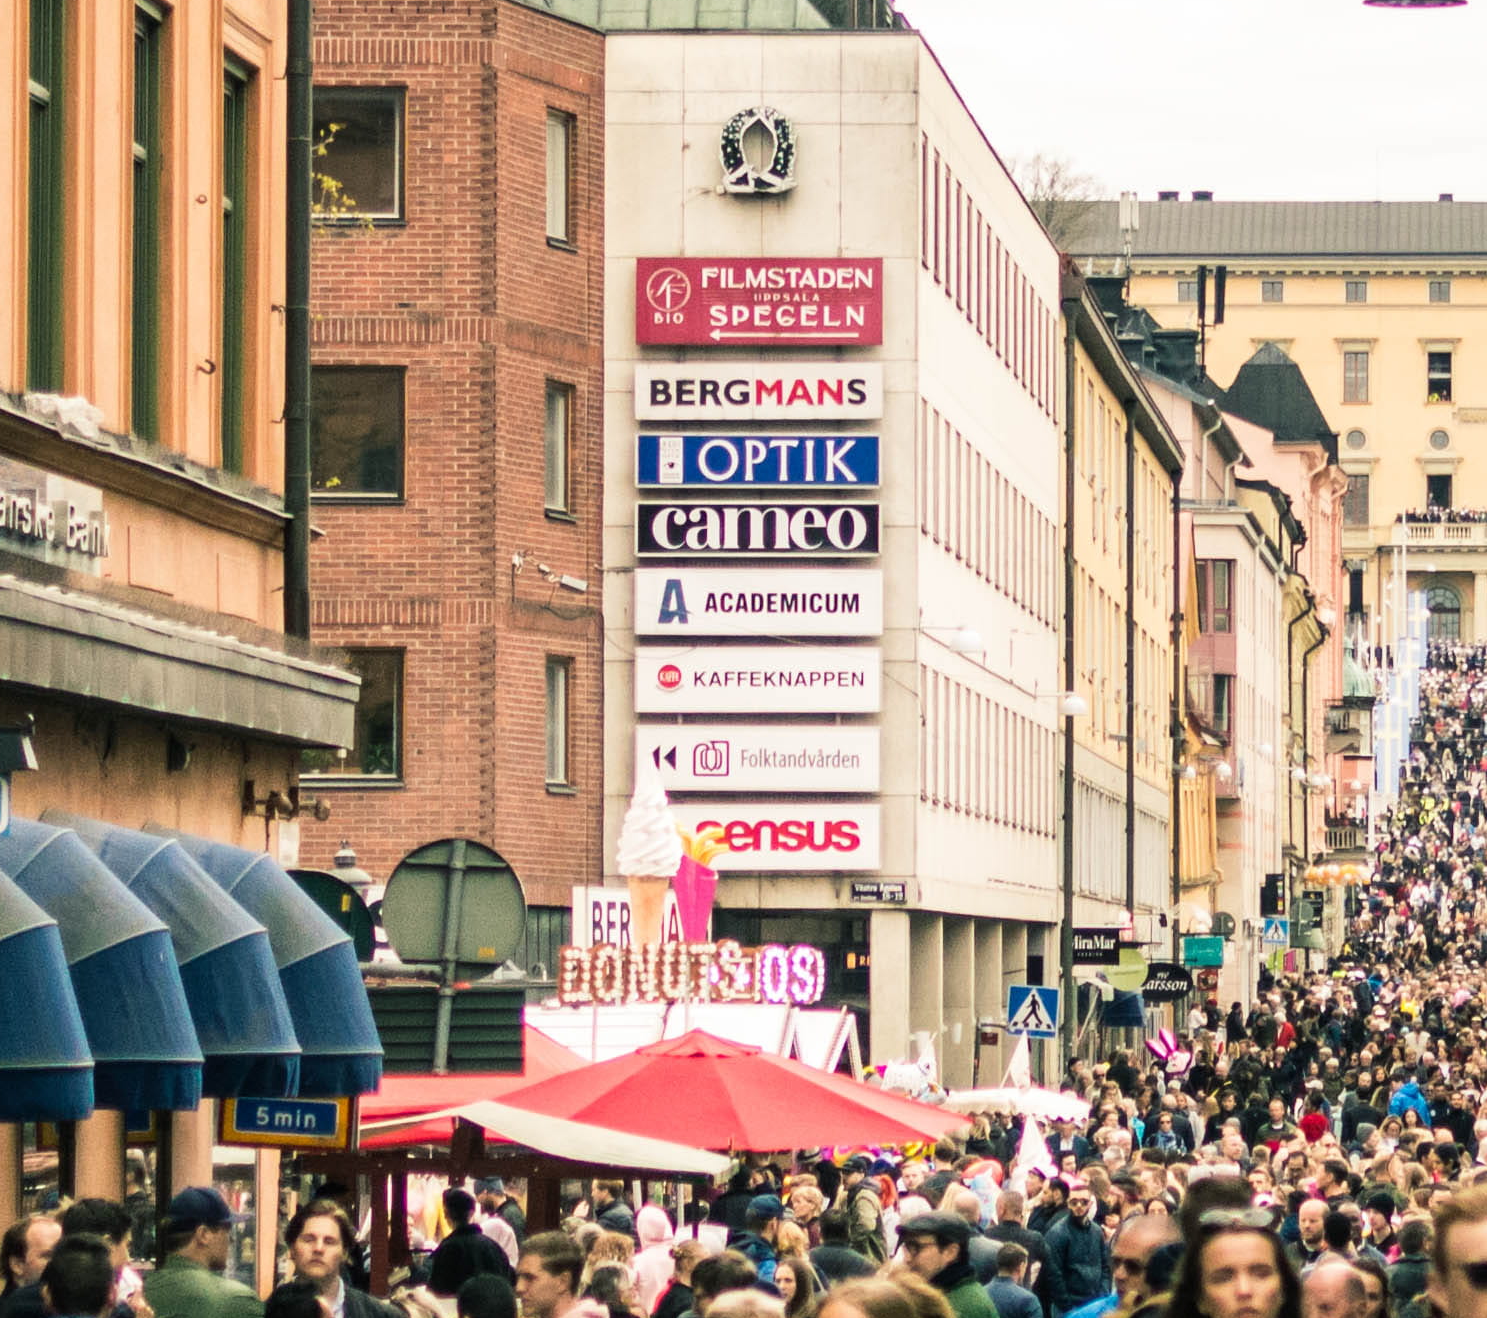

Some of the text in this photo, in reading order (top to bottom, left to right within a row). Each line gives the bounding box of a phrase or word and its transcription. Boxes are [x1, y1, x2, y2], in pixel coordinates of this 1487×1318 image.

[700, 267, 873, 289] FILMSTADEN
[753, 293, 821, 302] UPPSALA
[654, 313, 684, 324] BIO
[709, 305, 865, 327] SPEGELN
[650, 378, 867, 406] BERGMANS
[697, 439, 858, 482] OPTIK
[652, 507, 867, 550] cameo
[704, 592, 860, 613] ACADEMICUM
[694, 671, 864, 687] KAFFEKNAPPEN
[740, 748, 860, 769] Folktandvården
[1141, 978, 1188, 991] arsson
[256, 1106, 316, 1129] 5 min
